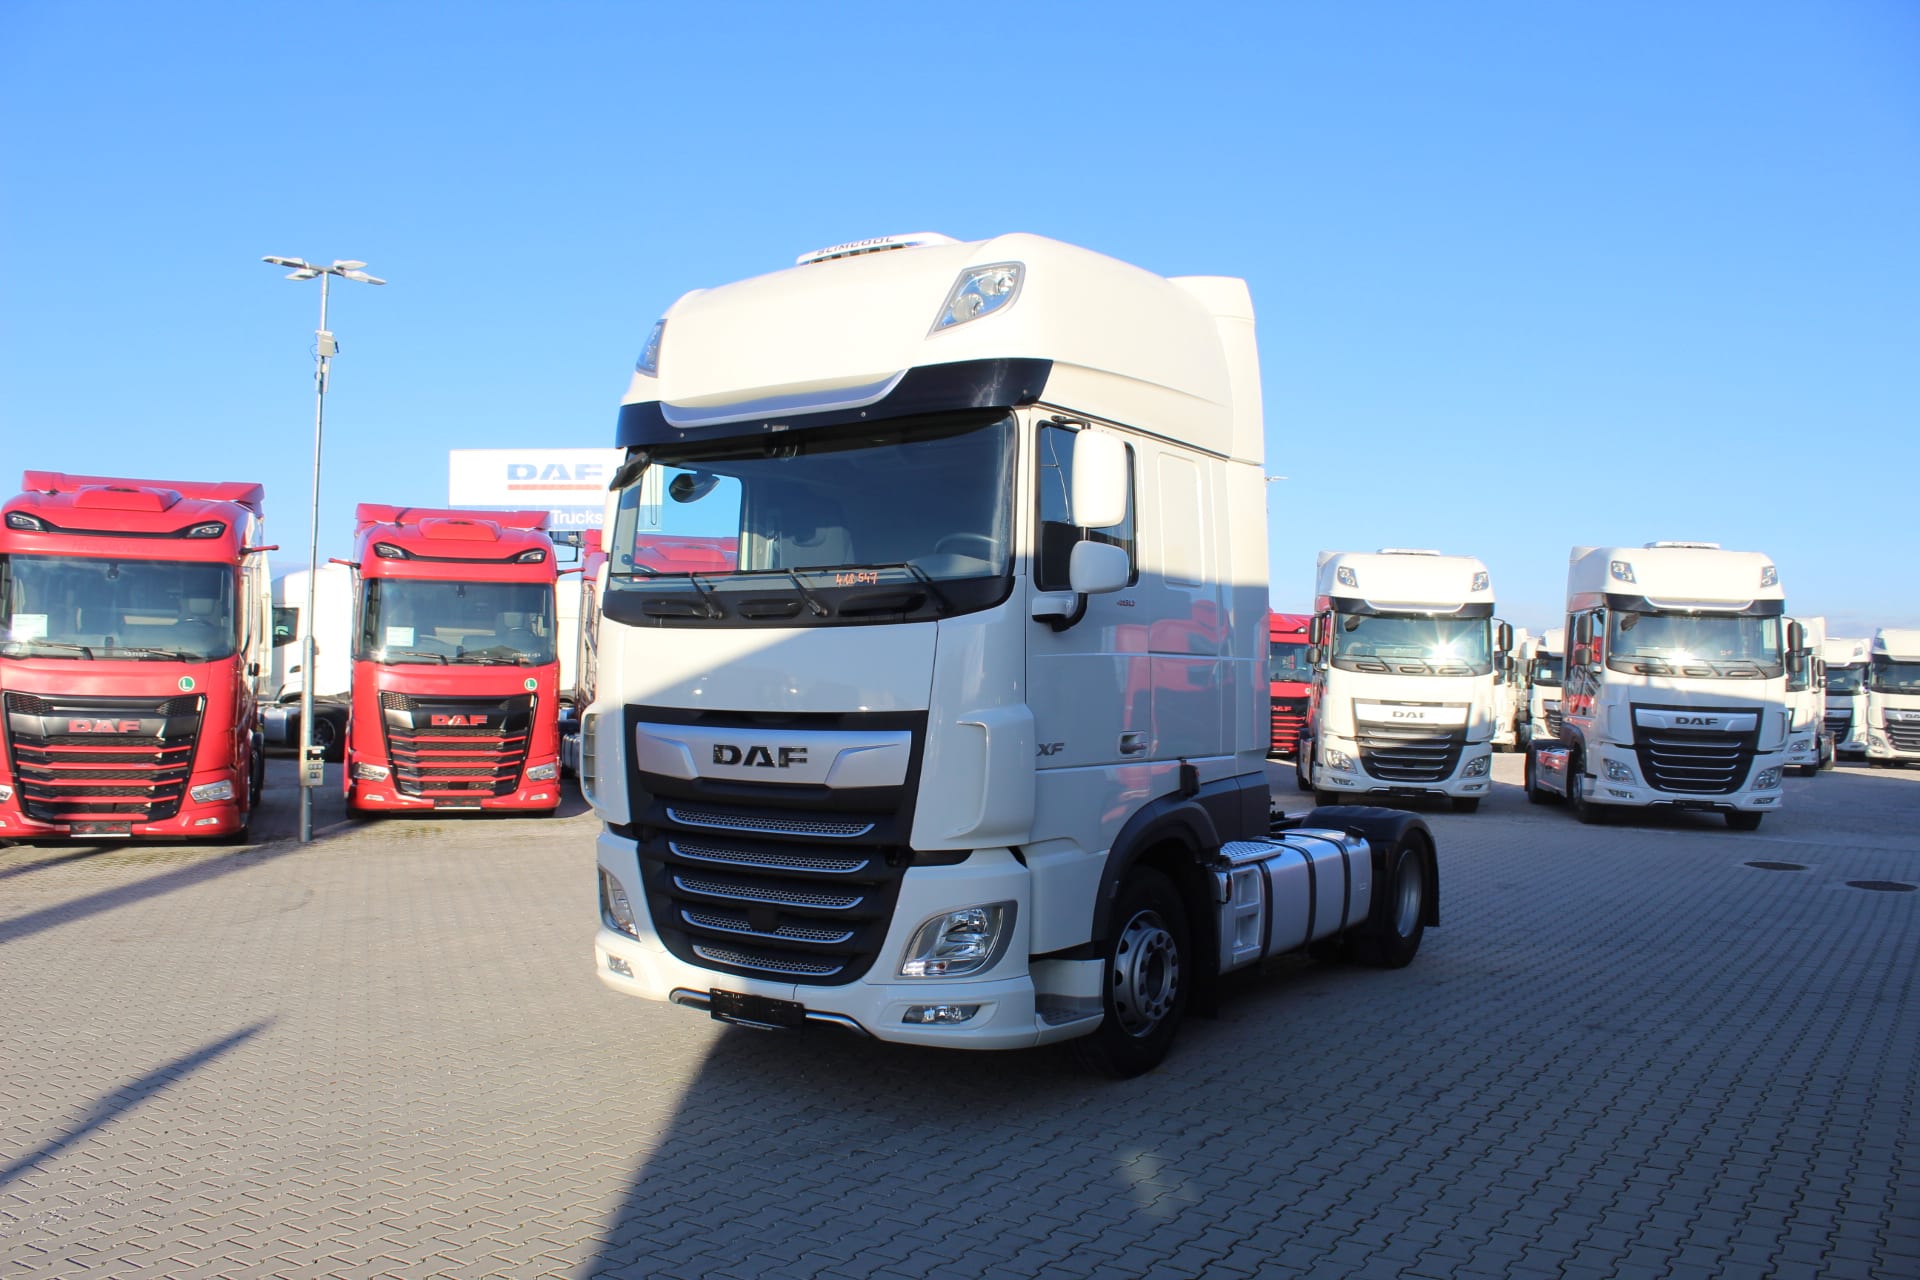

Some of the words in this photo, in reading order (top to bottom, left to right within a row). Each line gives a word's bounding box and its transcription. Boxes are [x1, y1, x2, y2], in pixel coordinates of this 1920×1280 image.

[507, 464, 603, 480] DAF
[552, 509, 603, 525] Trucks
[68, 720, 140, 733] DAF
[431, 715, 488, 725] DAF
[1676, 716, 1719, 725] DAF
[713, 744, 808, 768] DAF
[1037, 742, 1064, 757] XF
